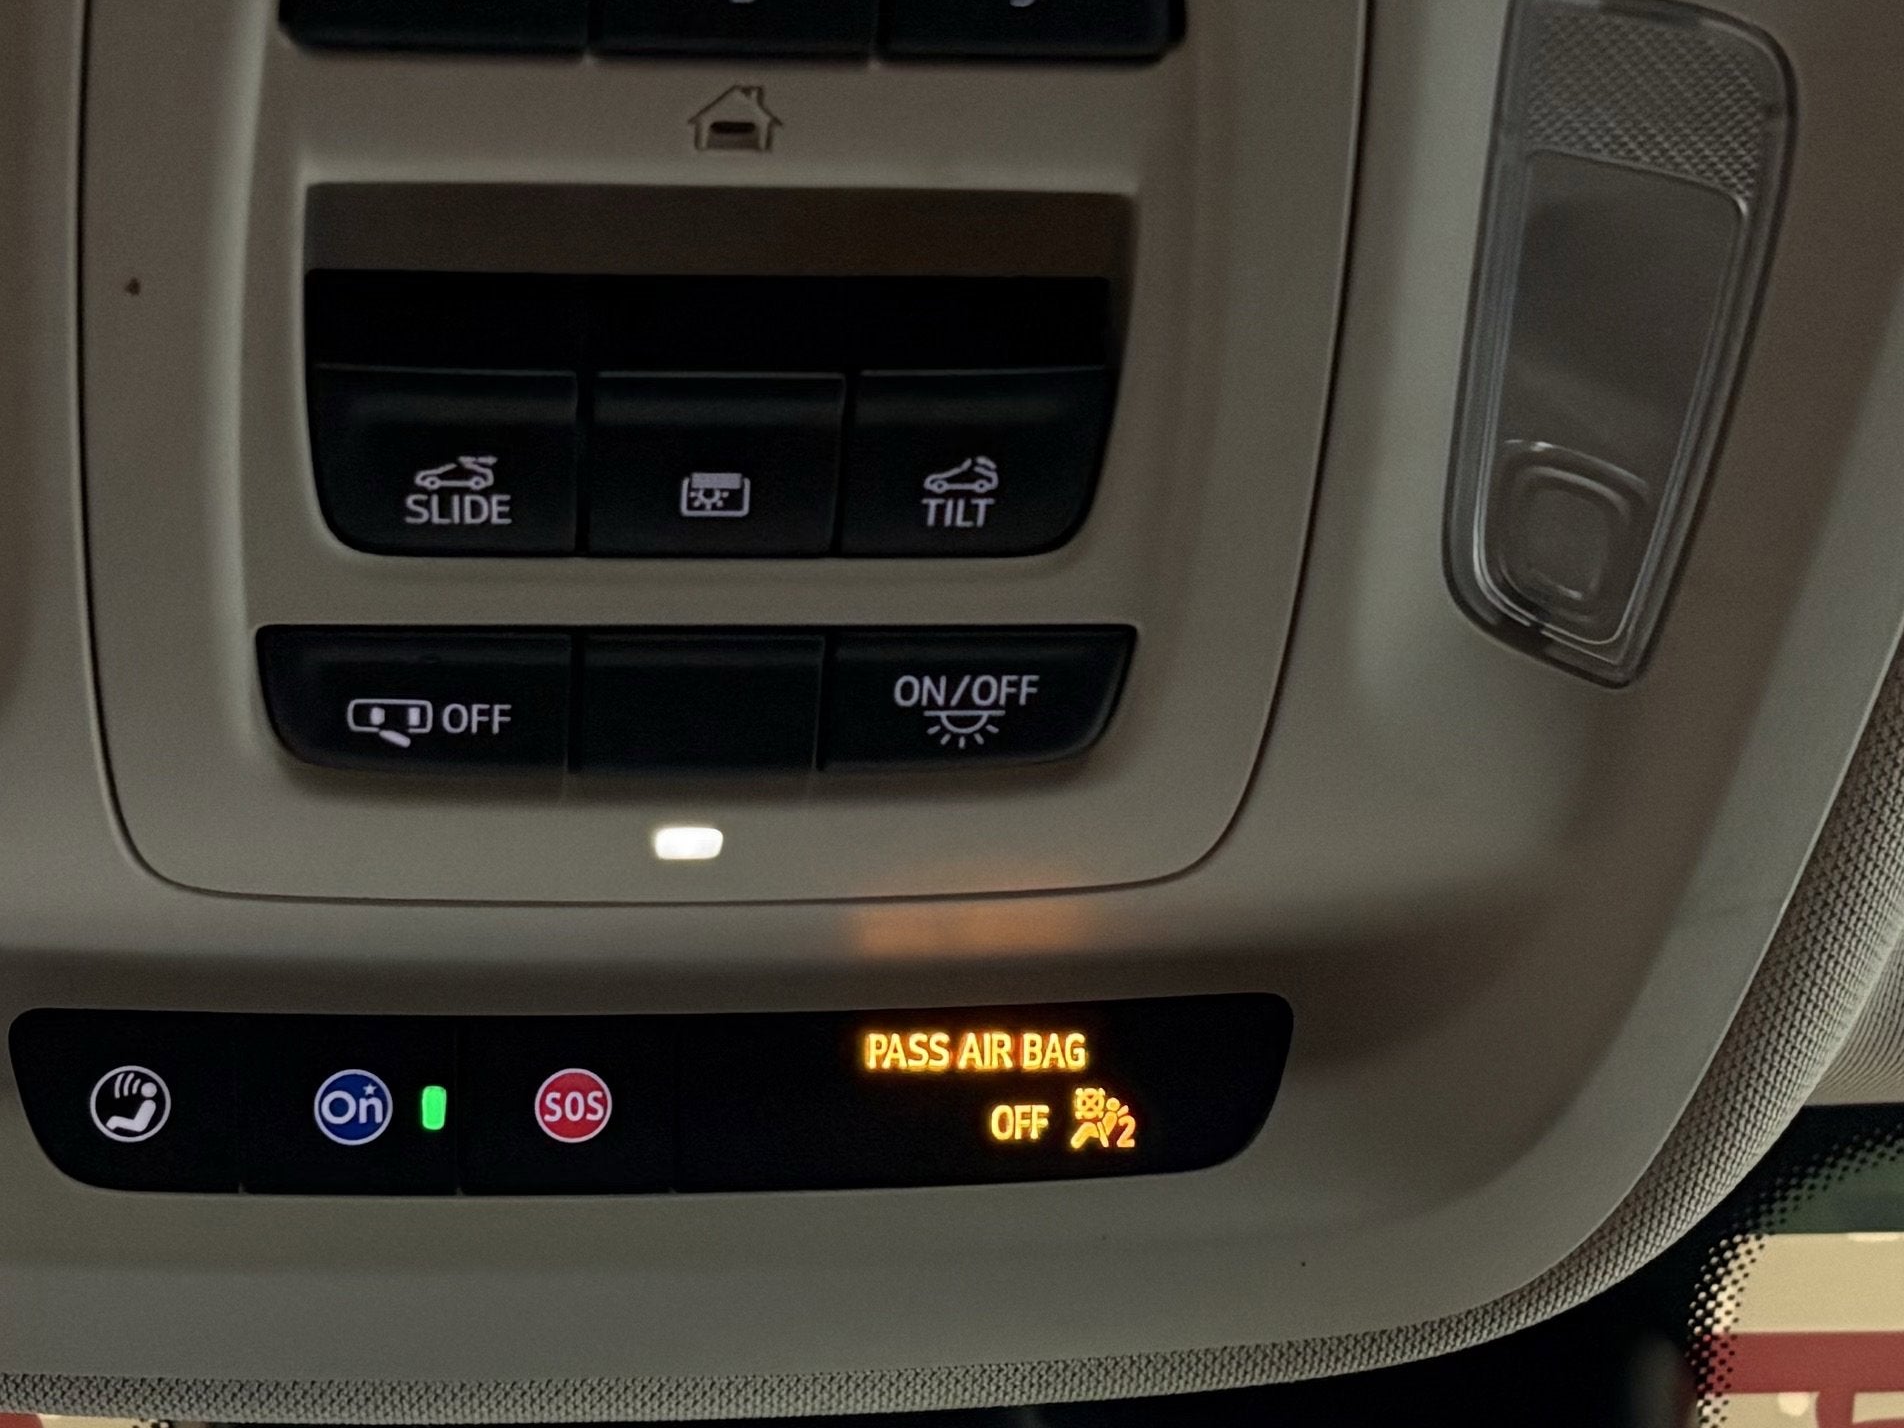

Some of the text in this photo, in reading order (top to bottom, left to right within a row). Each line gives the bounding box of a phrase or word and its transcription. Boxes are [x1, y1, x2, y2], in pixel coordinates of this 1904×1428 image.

[404, 492, 513, 526] SLIDE
[921, 497, 995, 528] TILT
[893, 672, 1040, 709] ON/OFF
[441, 702, 513, 735] OFF
[863, 1031, 1088, 1071] PASS AIR BAG
[320, 1083, 384, 1125] On
[543, 1090, 605, 1123] SOS
[989, 1103, 1050, 1142] OFF
